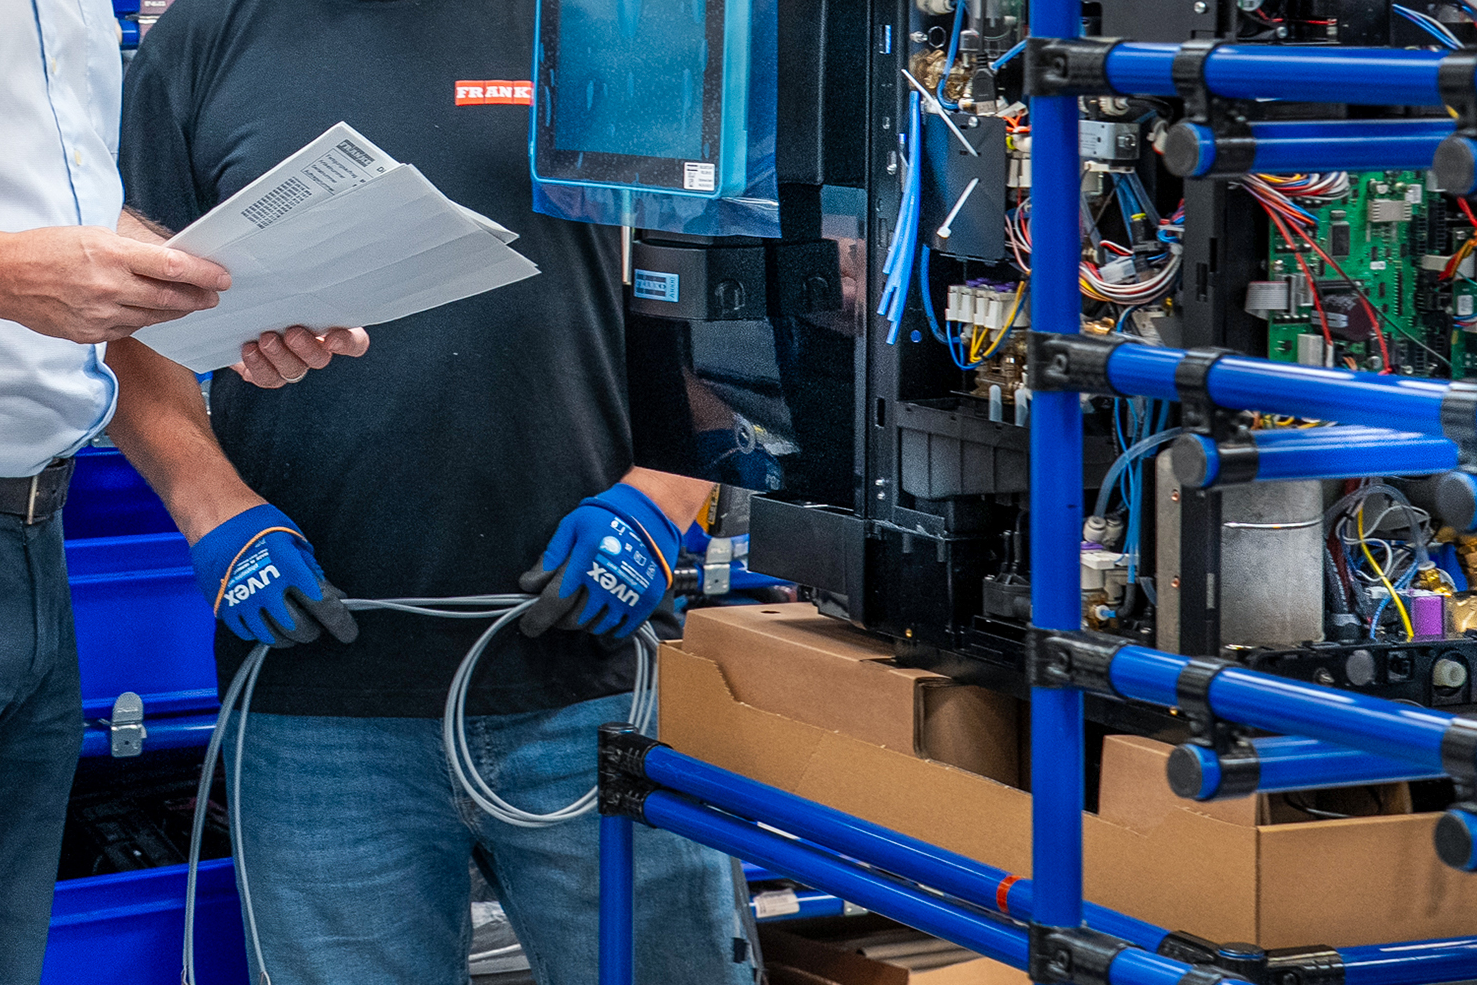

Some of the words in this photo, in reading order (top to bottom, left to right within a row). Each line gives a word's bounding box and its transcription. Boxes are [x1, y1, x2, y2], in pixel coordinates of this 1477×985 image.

[456, 85, 535, 99] FRANK
[223, 564, 281, 607] uvex
[586, 561, 640, 607] uvex
